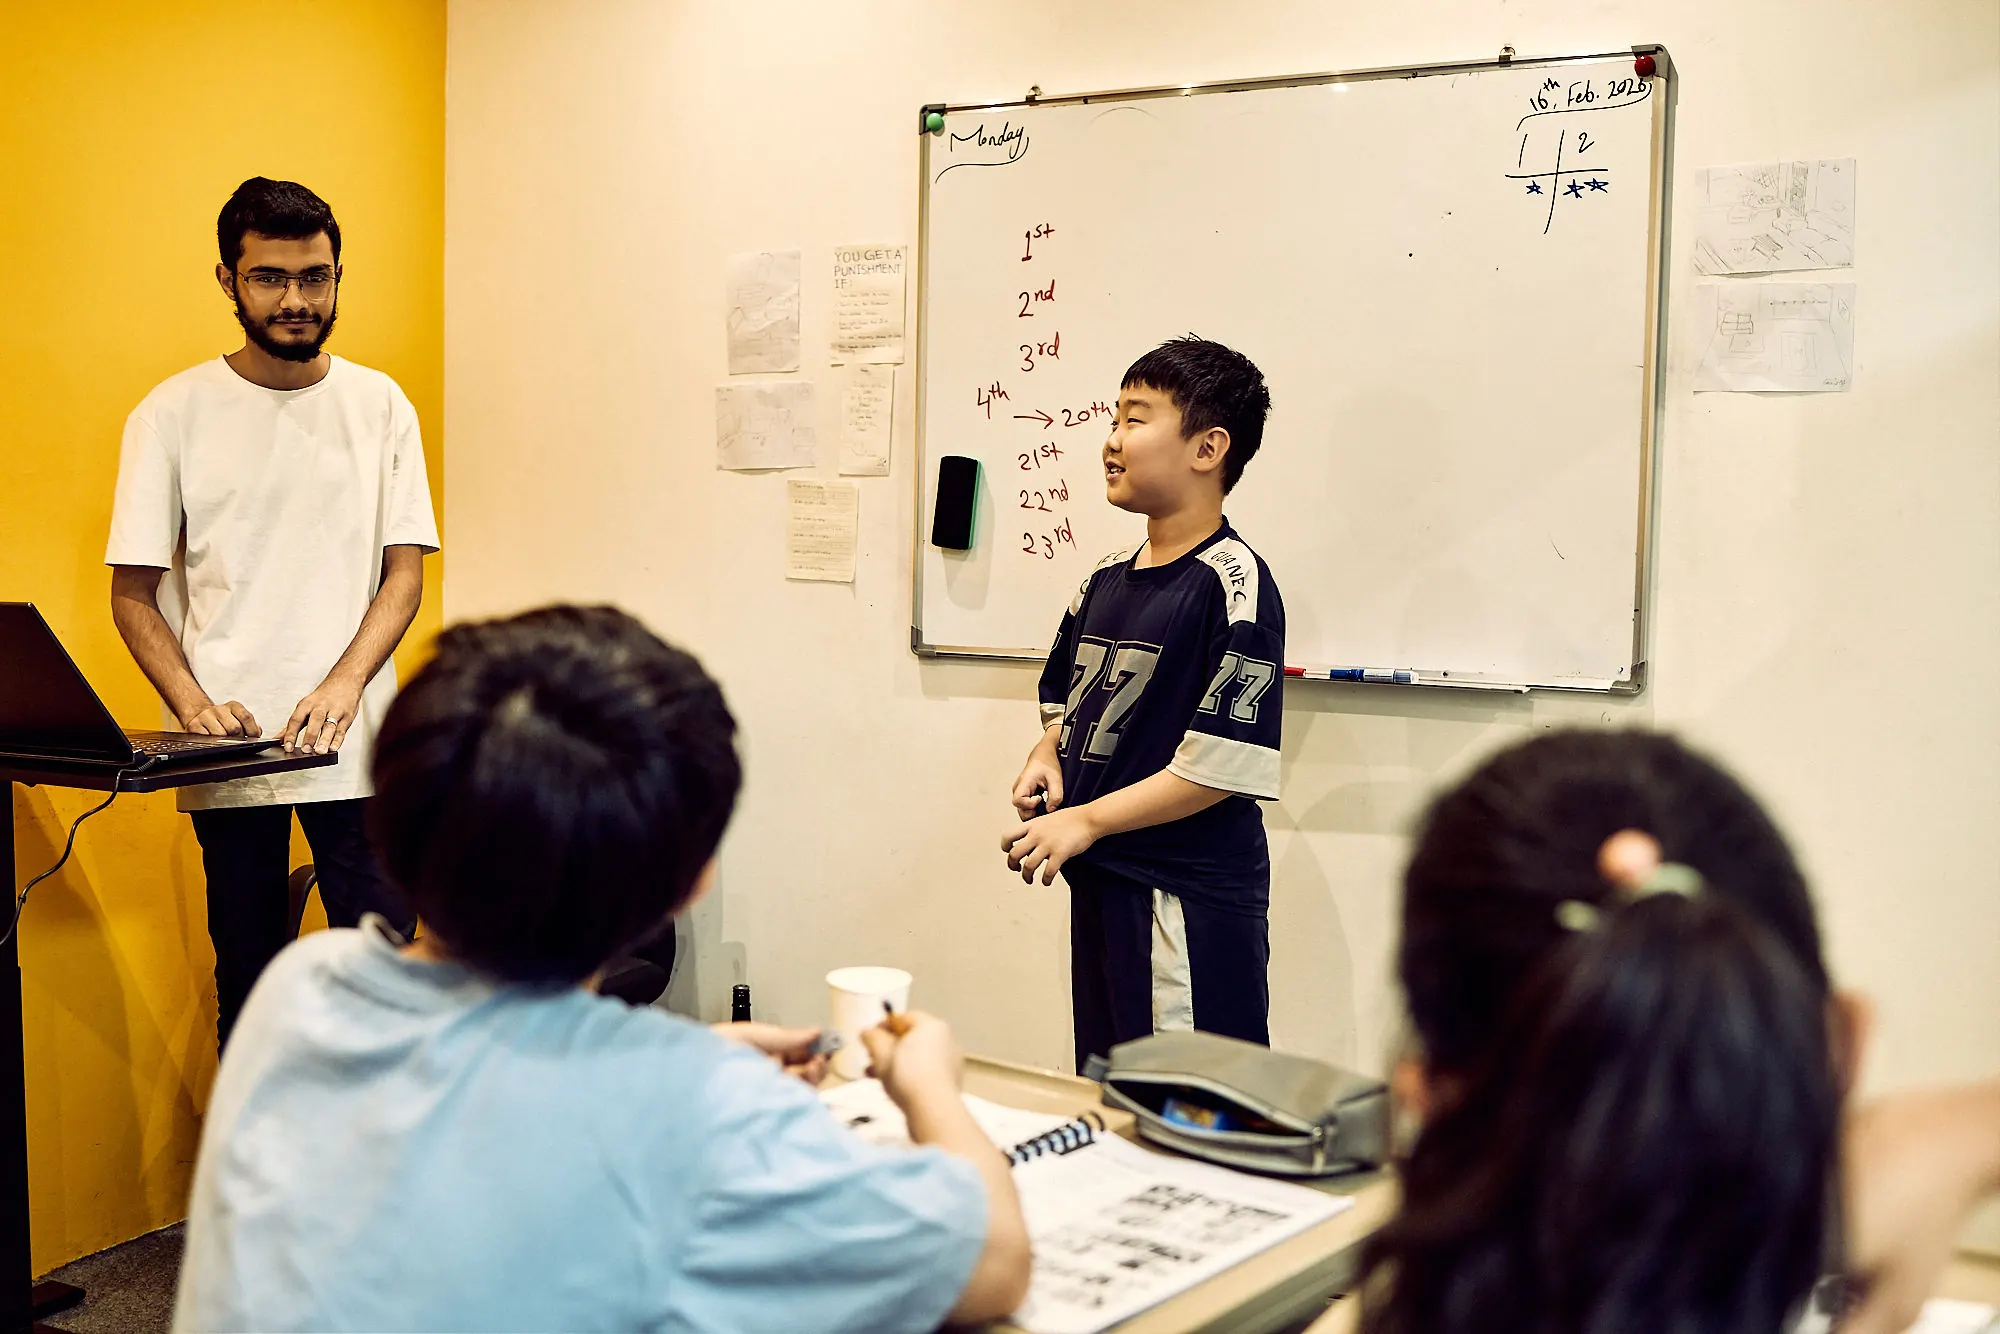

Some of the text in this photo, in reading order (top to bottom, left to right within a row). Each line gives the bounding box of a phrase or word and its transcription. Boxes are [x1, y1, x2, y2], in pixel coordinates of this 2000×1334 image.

[1567, 79, 1600, 107] Feb.
[1607, 77, 1647, 100] 2026
[950, 121, 1028, 160] Monday
[1577, 131, 1595, 154] 2
[834, 249, 902, 263] YOU GET A
[1020, 222, 1056, 262] 1st
[834, 264, 901, 277] PUNISHMENT
[834, 279, 853, 289] IF:
[1018, 279, 1056, 318] 2nd
[1019, 331, 1061, 373] 3rd
[977, 381, 1114, 428] 4th 20th
[1017, 441, 1065, 471] 21st
[1019, 478, 1070, 513] 22nd
[1022, 516, 1078, 560] 23rd
[1058, 634, 1164, 764] 77
[1196, 650, 1277, 725] 77
